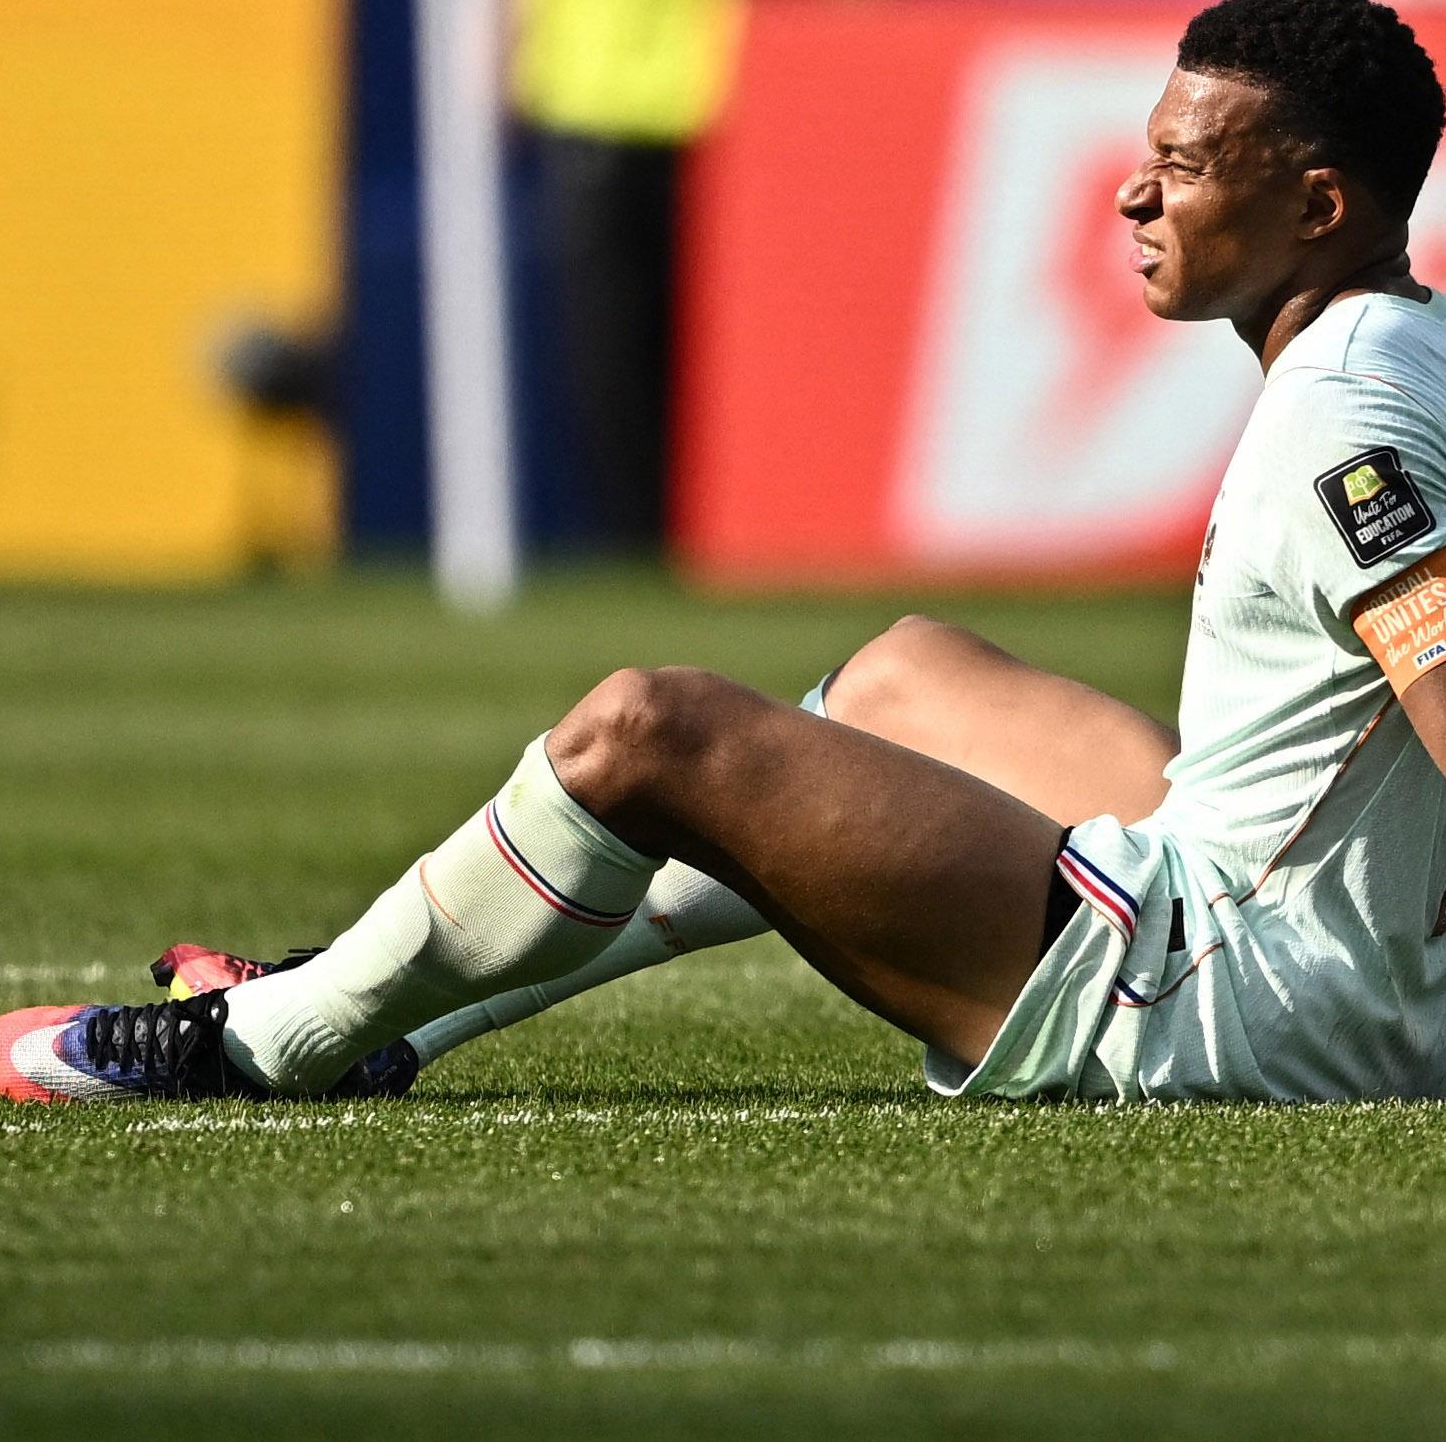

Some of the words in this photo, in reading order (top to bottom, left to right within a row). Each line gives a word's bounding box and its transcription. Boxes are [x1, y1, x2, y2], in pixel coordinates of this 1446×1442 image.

[1353, 500, 1383, 526] Unite
[1379, 491, 1398, 511] For
[1355, 502, 1416, 545] EDUCATION
[1380, 529, 1404, 546] FIFA
[1363, 567, 1441, 623] FOOTBALL
[1385, 639, 1412, 668] the
[1416, 644, 1446, 666] FIFA
